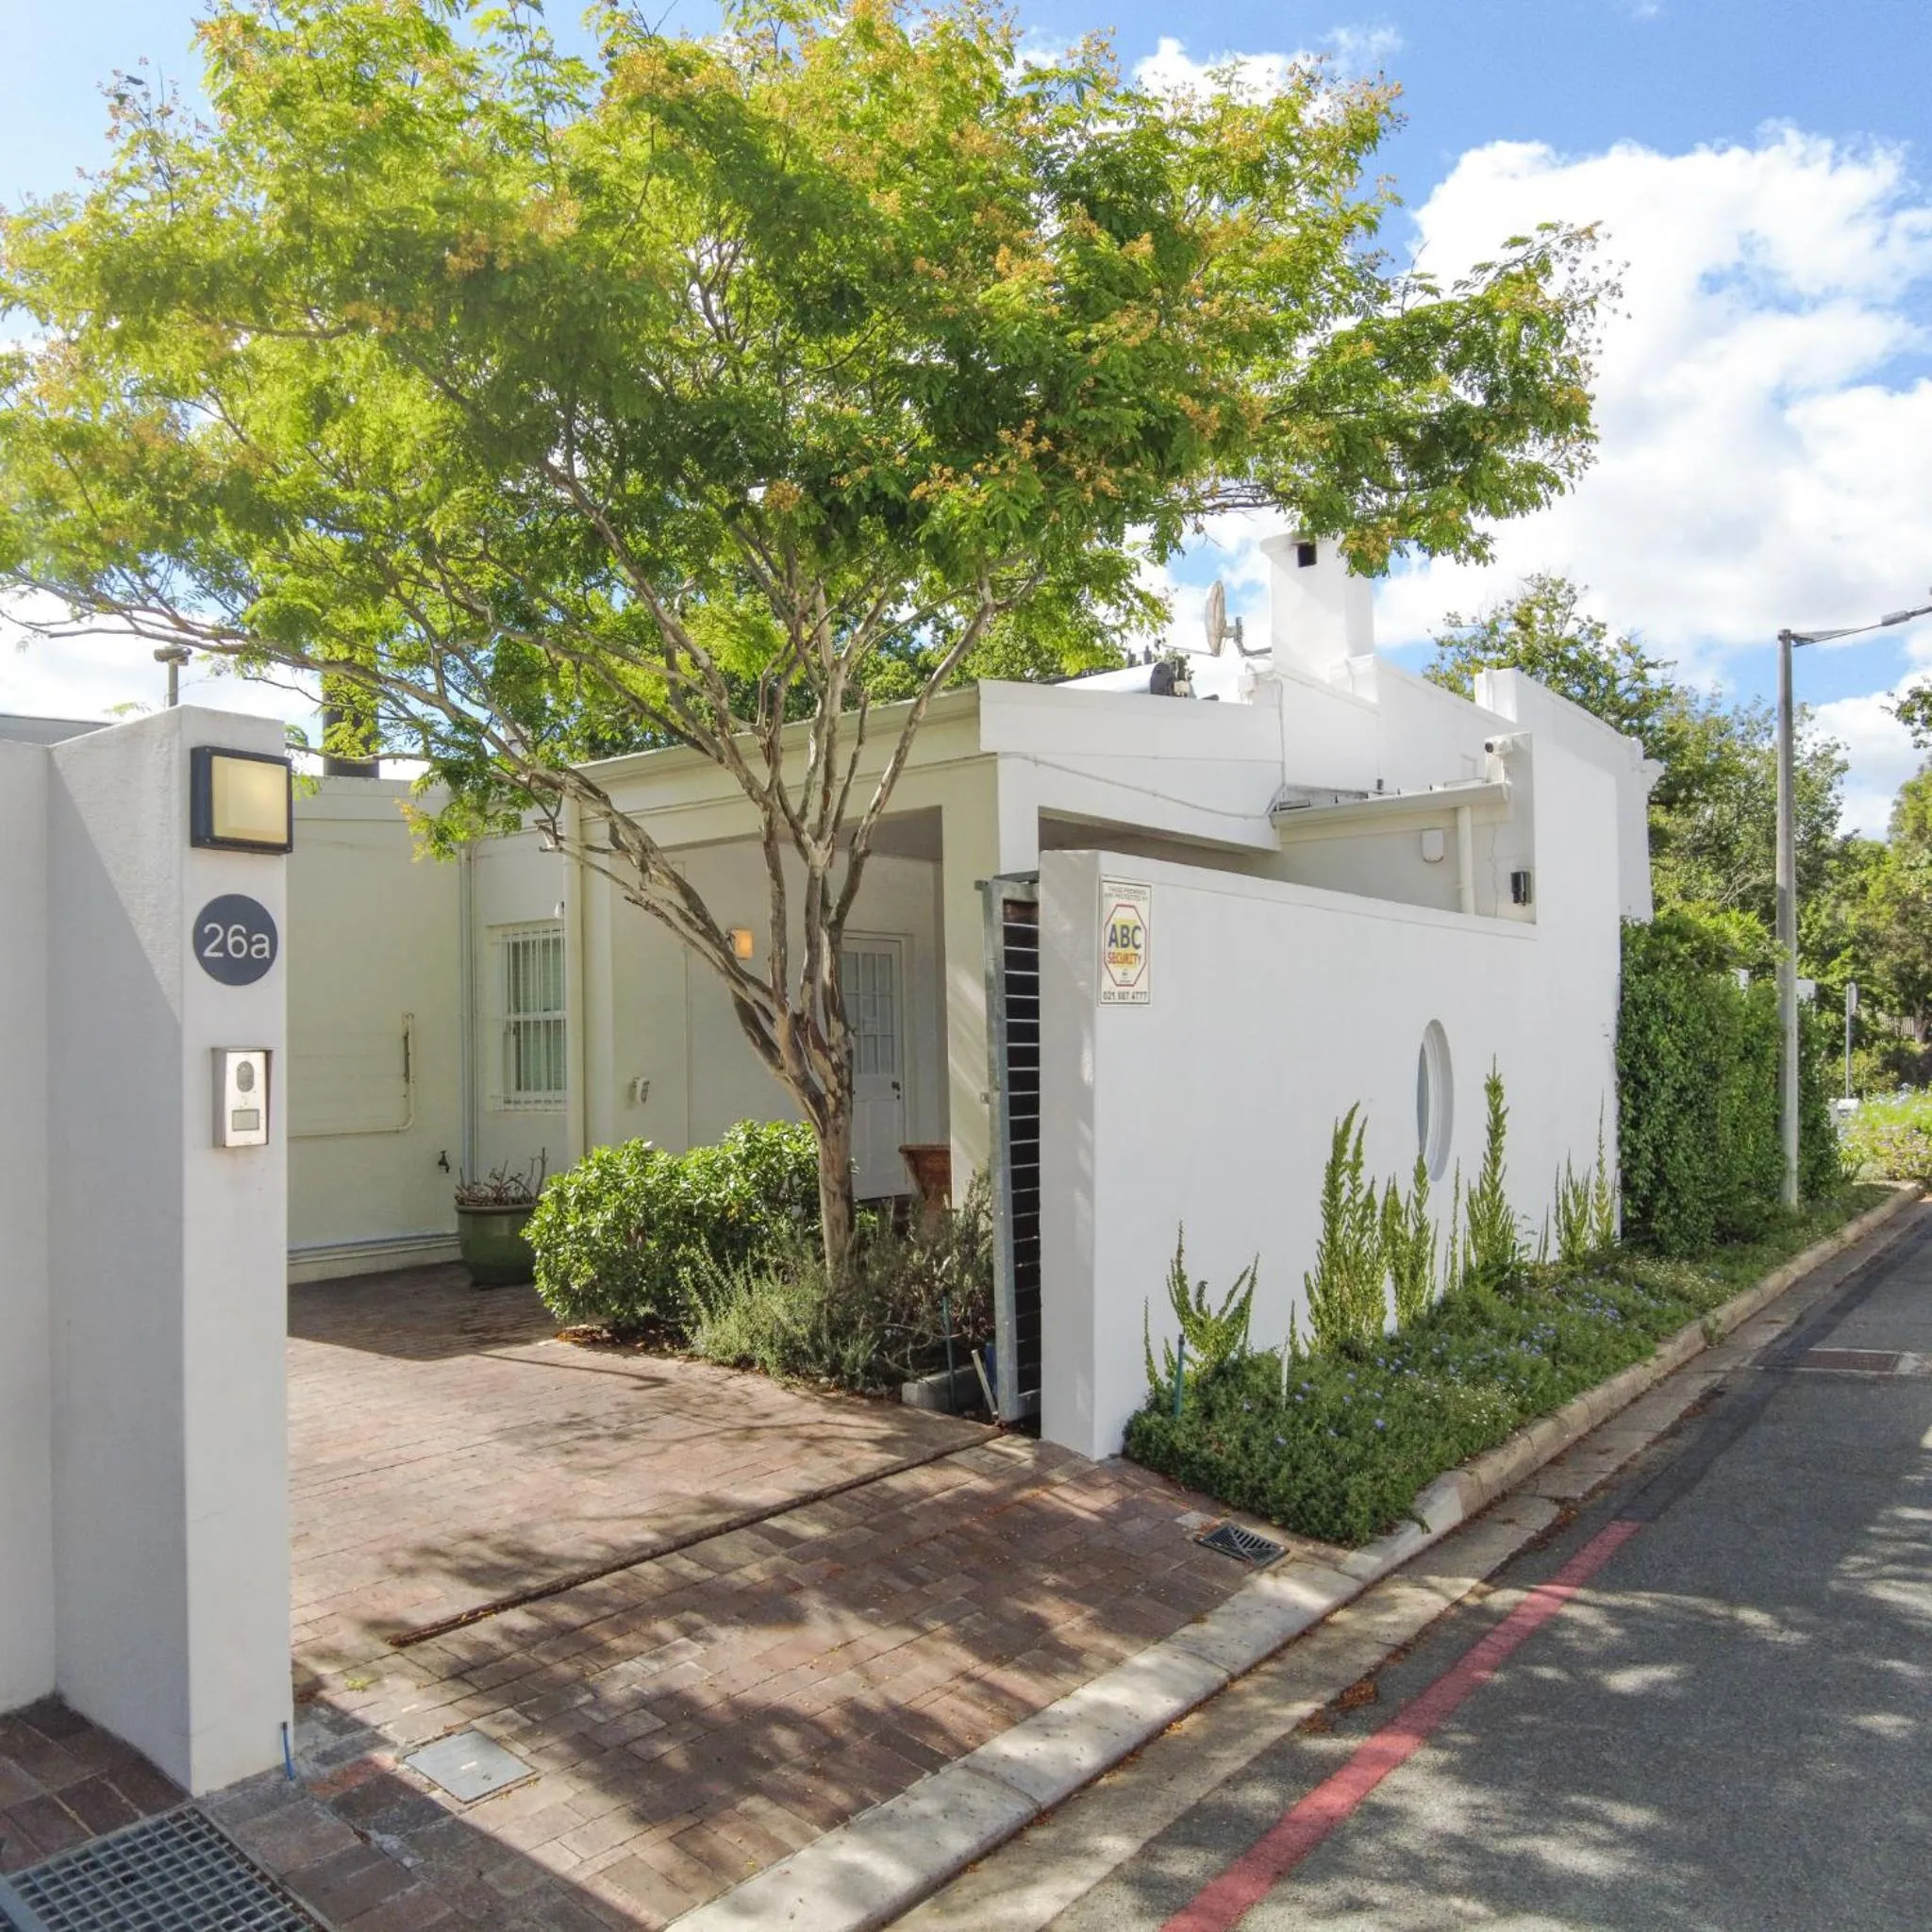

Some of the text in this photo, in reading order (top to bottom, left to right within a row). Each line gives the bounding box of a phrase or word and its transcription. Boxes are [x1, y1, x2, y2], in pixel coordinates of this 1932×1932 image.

[203, 923, 270, 958] 26a
[1108, 924, 1141, 949] ABC
[1108, 952, 1141, 964] SECURITY
